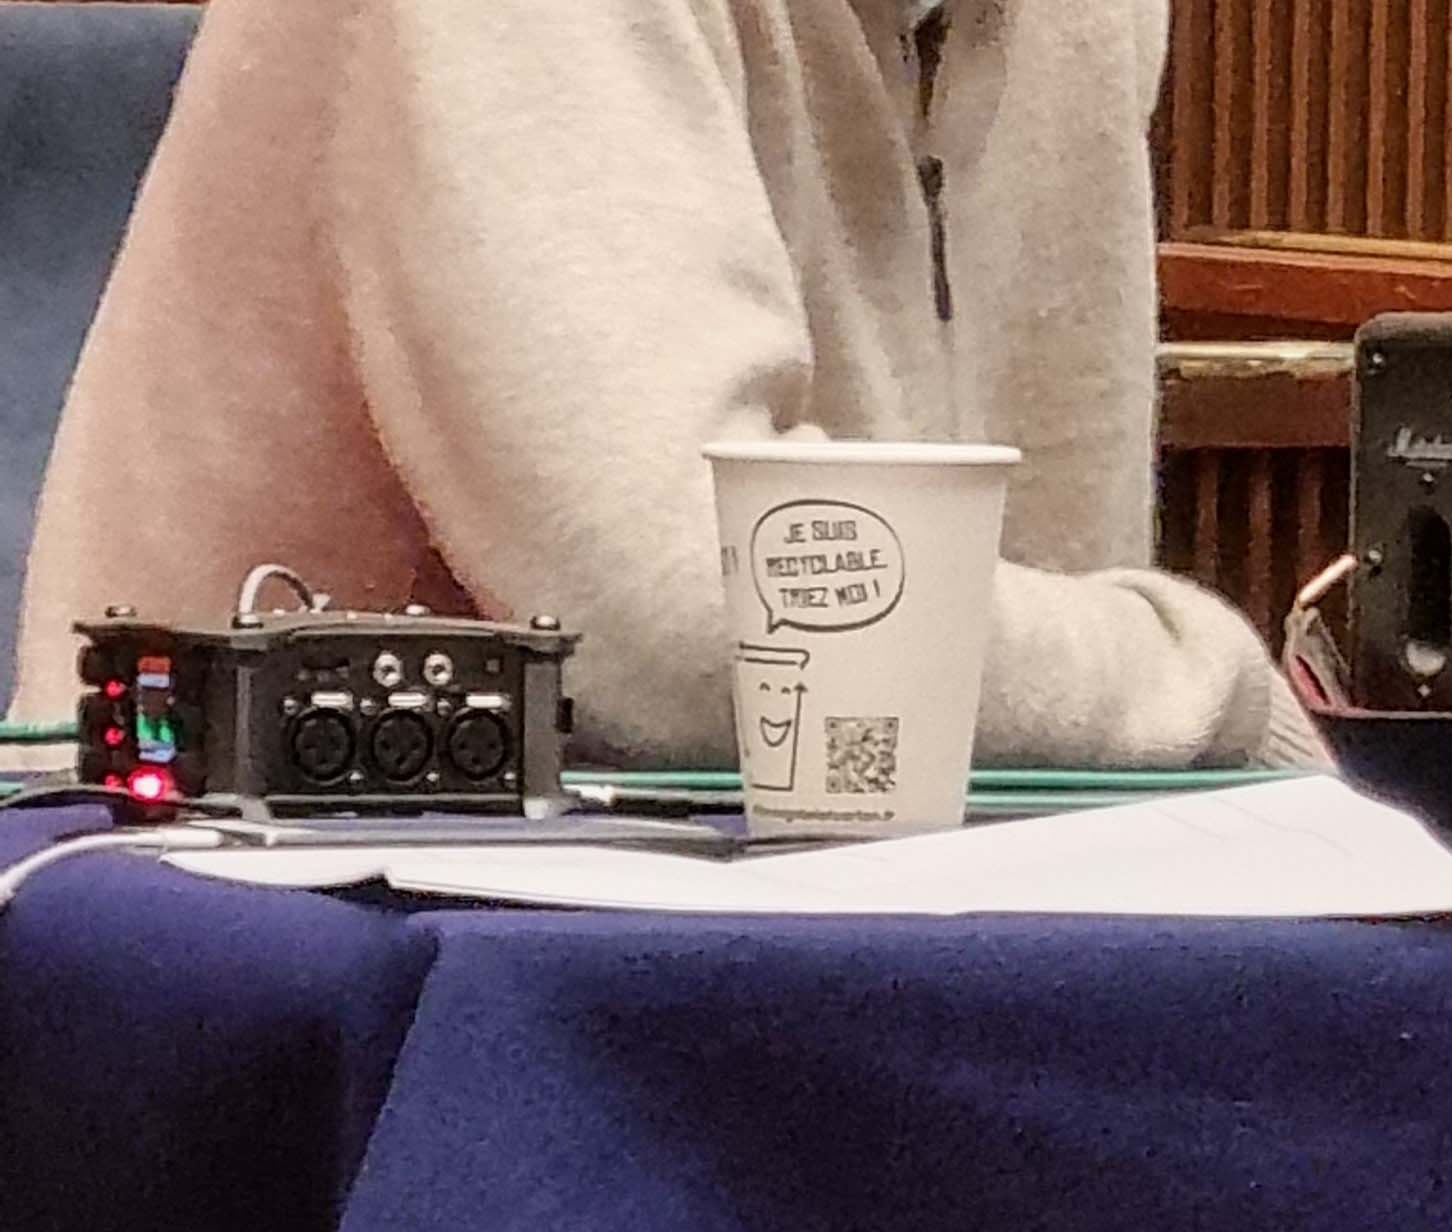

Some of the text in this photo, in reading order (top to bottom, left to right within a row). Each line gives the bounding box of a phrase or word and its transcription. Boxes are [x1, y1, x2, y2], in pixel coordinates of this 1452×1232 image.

[784, 519, 858, 544] JE SUIS
[766, 548, 889, 578] RECYCLABLE
[778, 586, 829, 609] TRIEZ
